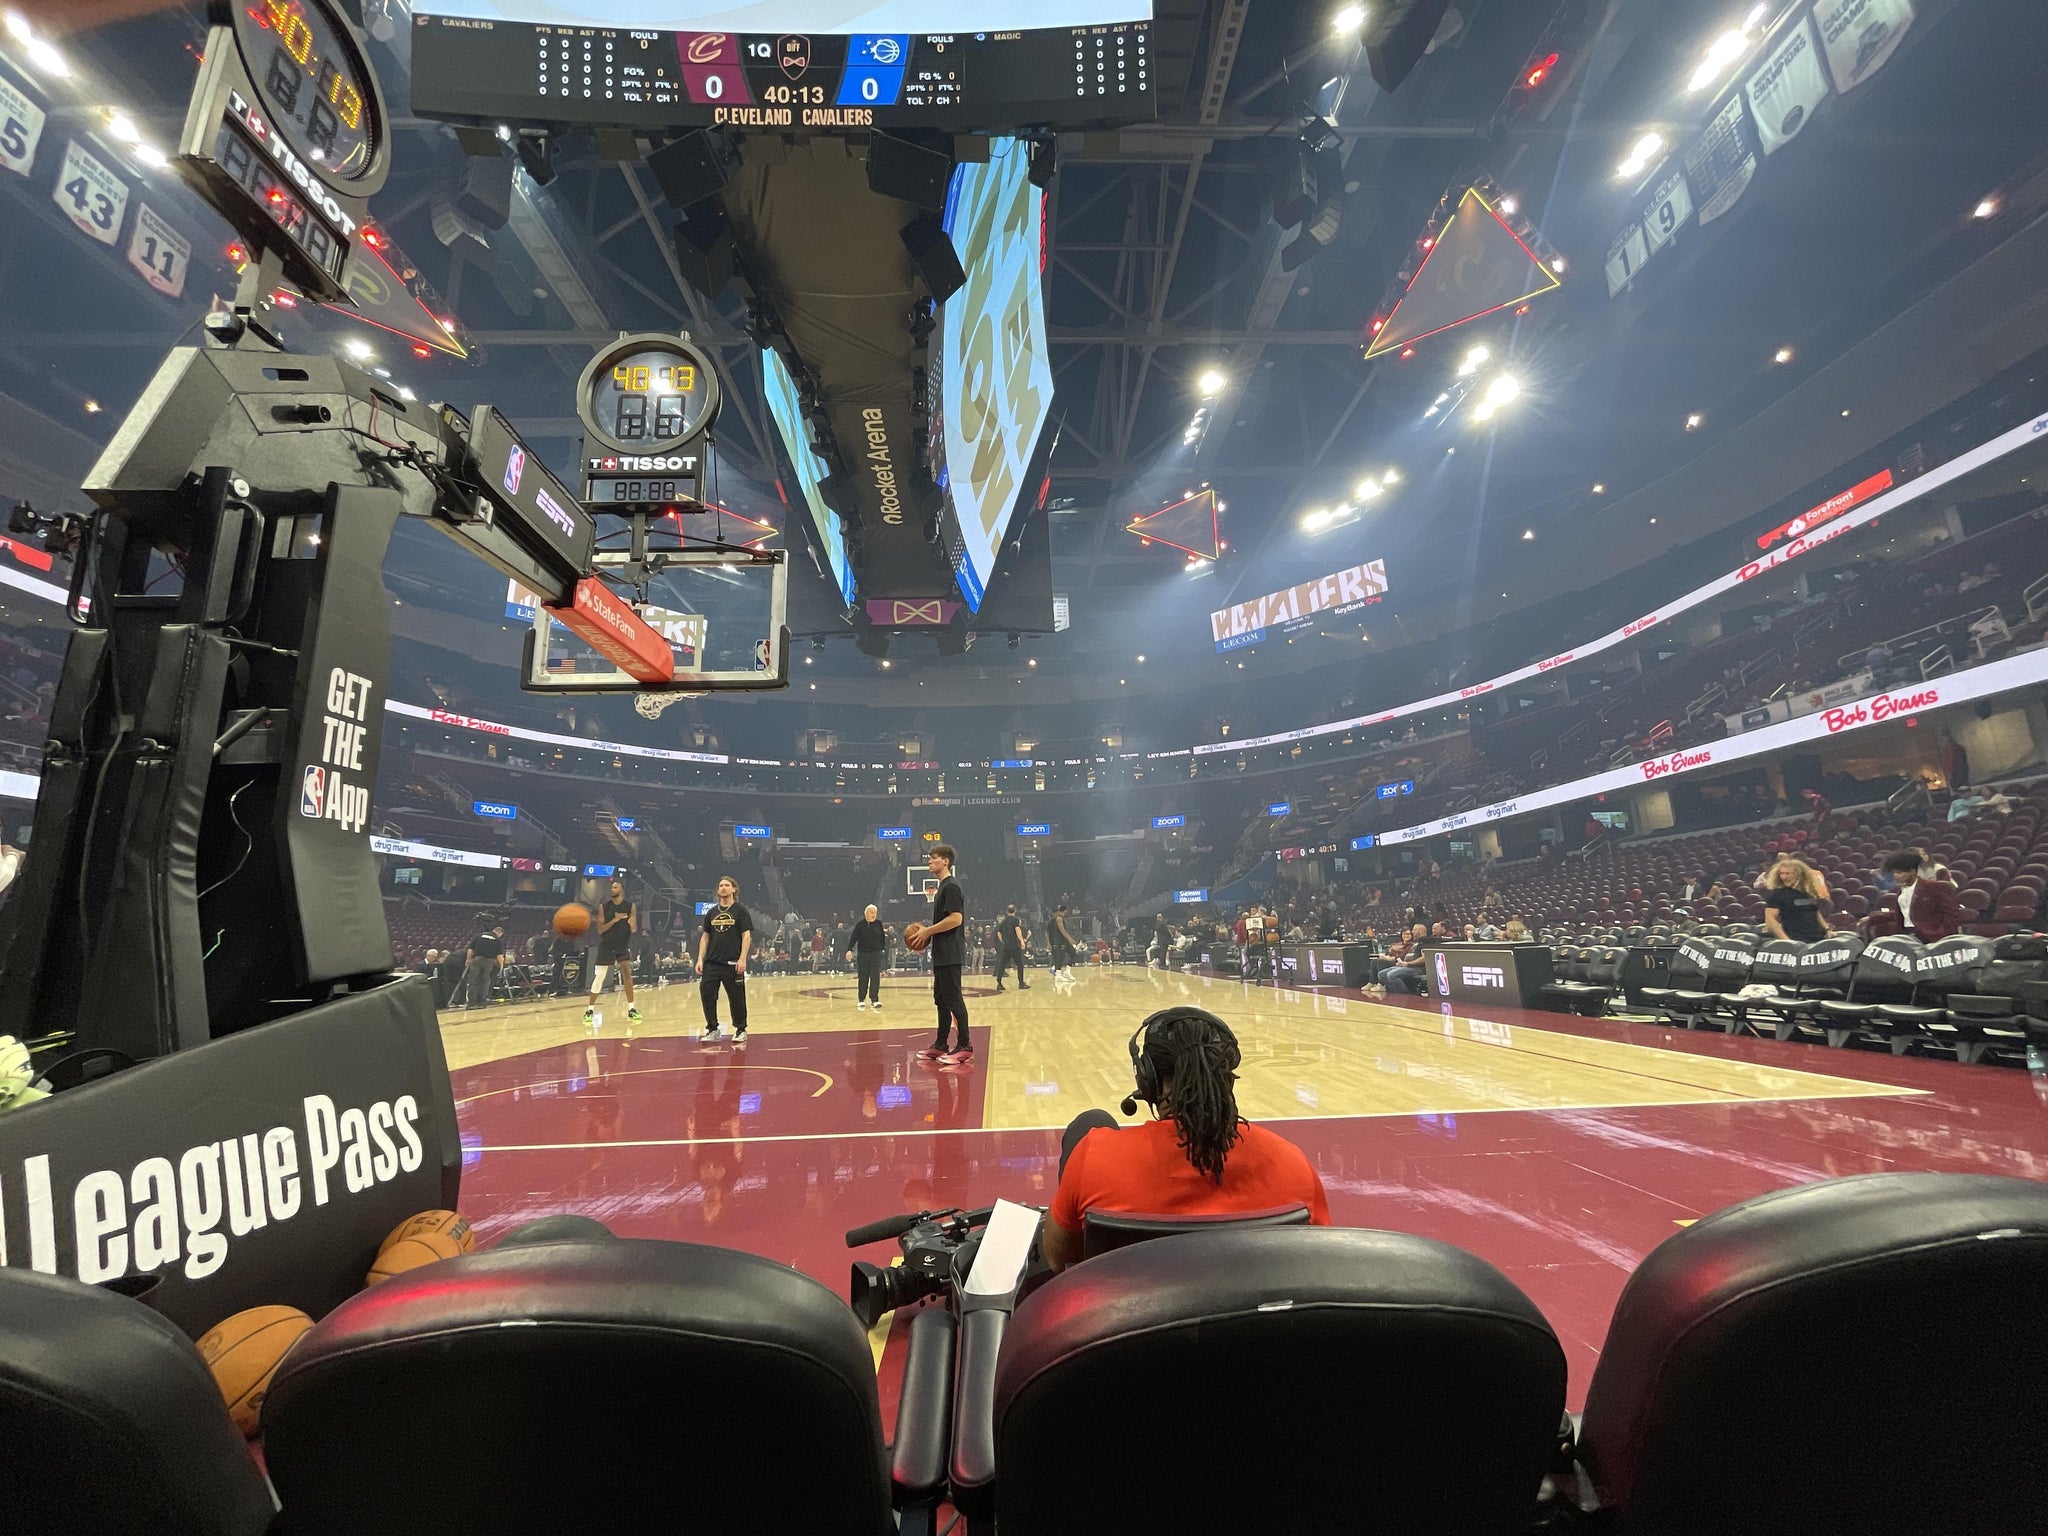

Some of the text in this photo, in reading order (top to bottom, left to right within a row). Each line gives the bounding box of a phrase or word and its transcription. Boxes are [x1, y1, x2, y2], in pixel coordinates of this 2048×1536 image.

[442, 18, 494, 30] CAVALIERS
[536, 26, 552, 34] PTS
[630, 32, 658, 40] FOULS
[640, 40, 648, 49] 0
[748, 44, 770, 58] 1Q
[937, 44, 944, 53] 0
[657, 68, 664, 76] 0
[949, 72, 955, 80] 0
[706, 76, 722, 98] 0
[862, 78, 878, 100] 0
[624, 93, 642, 101] TOL
[646, 93, 651, 101] 7
[656, 94, 670, 102] CH
[764, 86, 824, 104] 40:13
[714, 107, 872, 126] CLEVELAND CAVALIERS
[269, 131, 356, 236] TISSOT
[65, 176, 115, 230] 43
[1658, 200, 1675, 234] 9
[142, 236, 174, 283] 11
[1618, 247, 1631, 278] 1
[614, 366, 694, 392] 40:13
[623, 457, 696, 470] TISSOT
[864, 408, 901, 514] Rocket Arena
[536, 488, 574, 538] ESPN
[1806, 492, 1854, 522] ForeFront
[1334, 601, 1366, 615] KeyBank
[1622, 624, 1637, 637] Bob
[1538, 661, 1553, 672] Bob
[326, 667, 372, 722] GET
[1820, 706, 1867, 734] Bob
[1871, 688, 1939, 720] Evans
[322, 716, 367, 771] THE
[1640, 750, 1712, 780] Bob Evans
[325, 770, 368, 834] App
[480, 804, 510, 815] zoom
[1486, 803, 1517, 818] drug mart
[1157, 817, 1180, 825] zoom
[1442, 817, 1467, 829] drug mart
[741, 827, 766, 835] zoom
[1401, 830, 1415, 839] drug
[374, 840, 391, 852] drug
[393, 845, 409, 853] mart
[1300, 848, 1305, 856] 0
[1318, 844, 1337, 853] 40:13
[432, 850, 446, 860] drug
[550, 864, 577, 872] ASSISTS
[1679, 944, 1690, 955] GET
[1688, 950, 1701, 961] THE
[1714, 949, 1725, 958] GET
[1726, 950, 1738, 960] THE
[1756, 952, 1768, 963] GET
[1769, 953, 1782, 964] THE
[1801, 954, 1814, 966] GET
[1816, 952, 1830, 964] THE
[1862, 945, 1882, 958] GET
[1879, 948, 1896, 964] THE
[1322, 960, 1343, 974] ESPN
[1916, 957, 1933, 971] GET
[1934, 953, 1954, 968] THE
[1462, 966, 1504, 988] ESPN
[24, 1094, 424, 1285] League Pass
